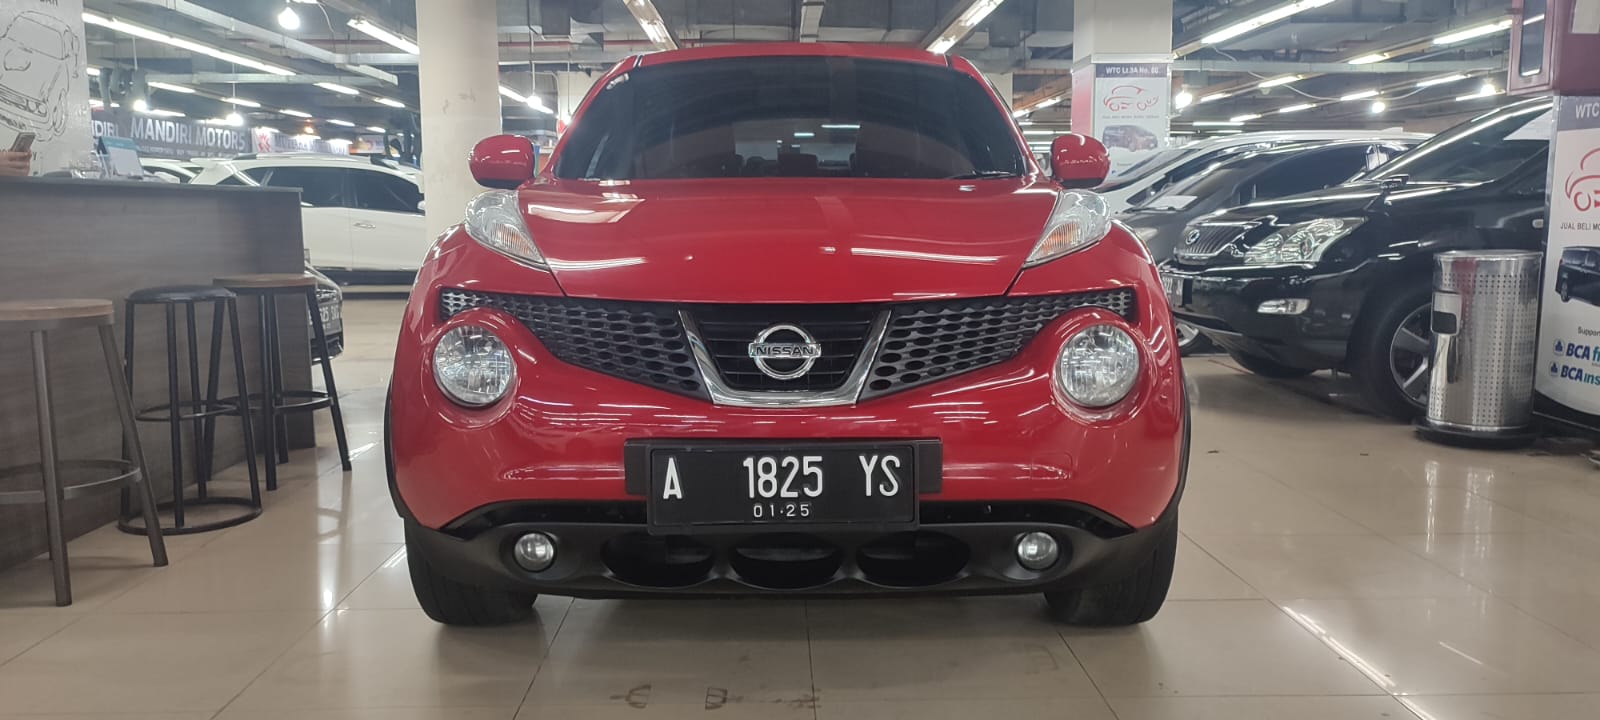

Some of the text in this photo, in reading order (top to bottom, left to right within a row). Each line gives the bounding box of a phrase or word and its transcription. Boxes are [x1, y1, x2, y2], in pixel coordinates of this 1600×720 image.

[1575, 102, 1599, 119] WTC
[91, 120, 119, 137] DIRI
[130, 117, 246, 150] MANDIRI MOTORS
[1560, 222, 1576, 230] JUAL
[756, 346, 813, 356] NISSAN
[1566, 343, 1591, 360] BCA
[663, 455, 900, 499] A 1825 YS
